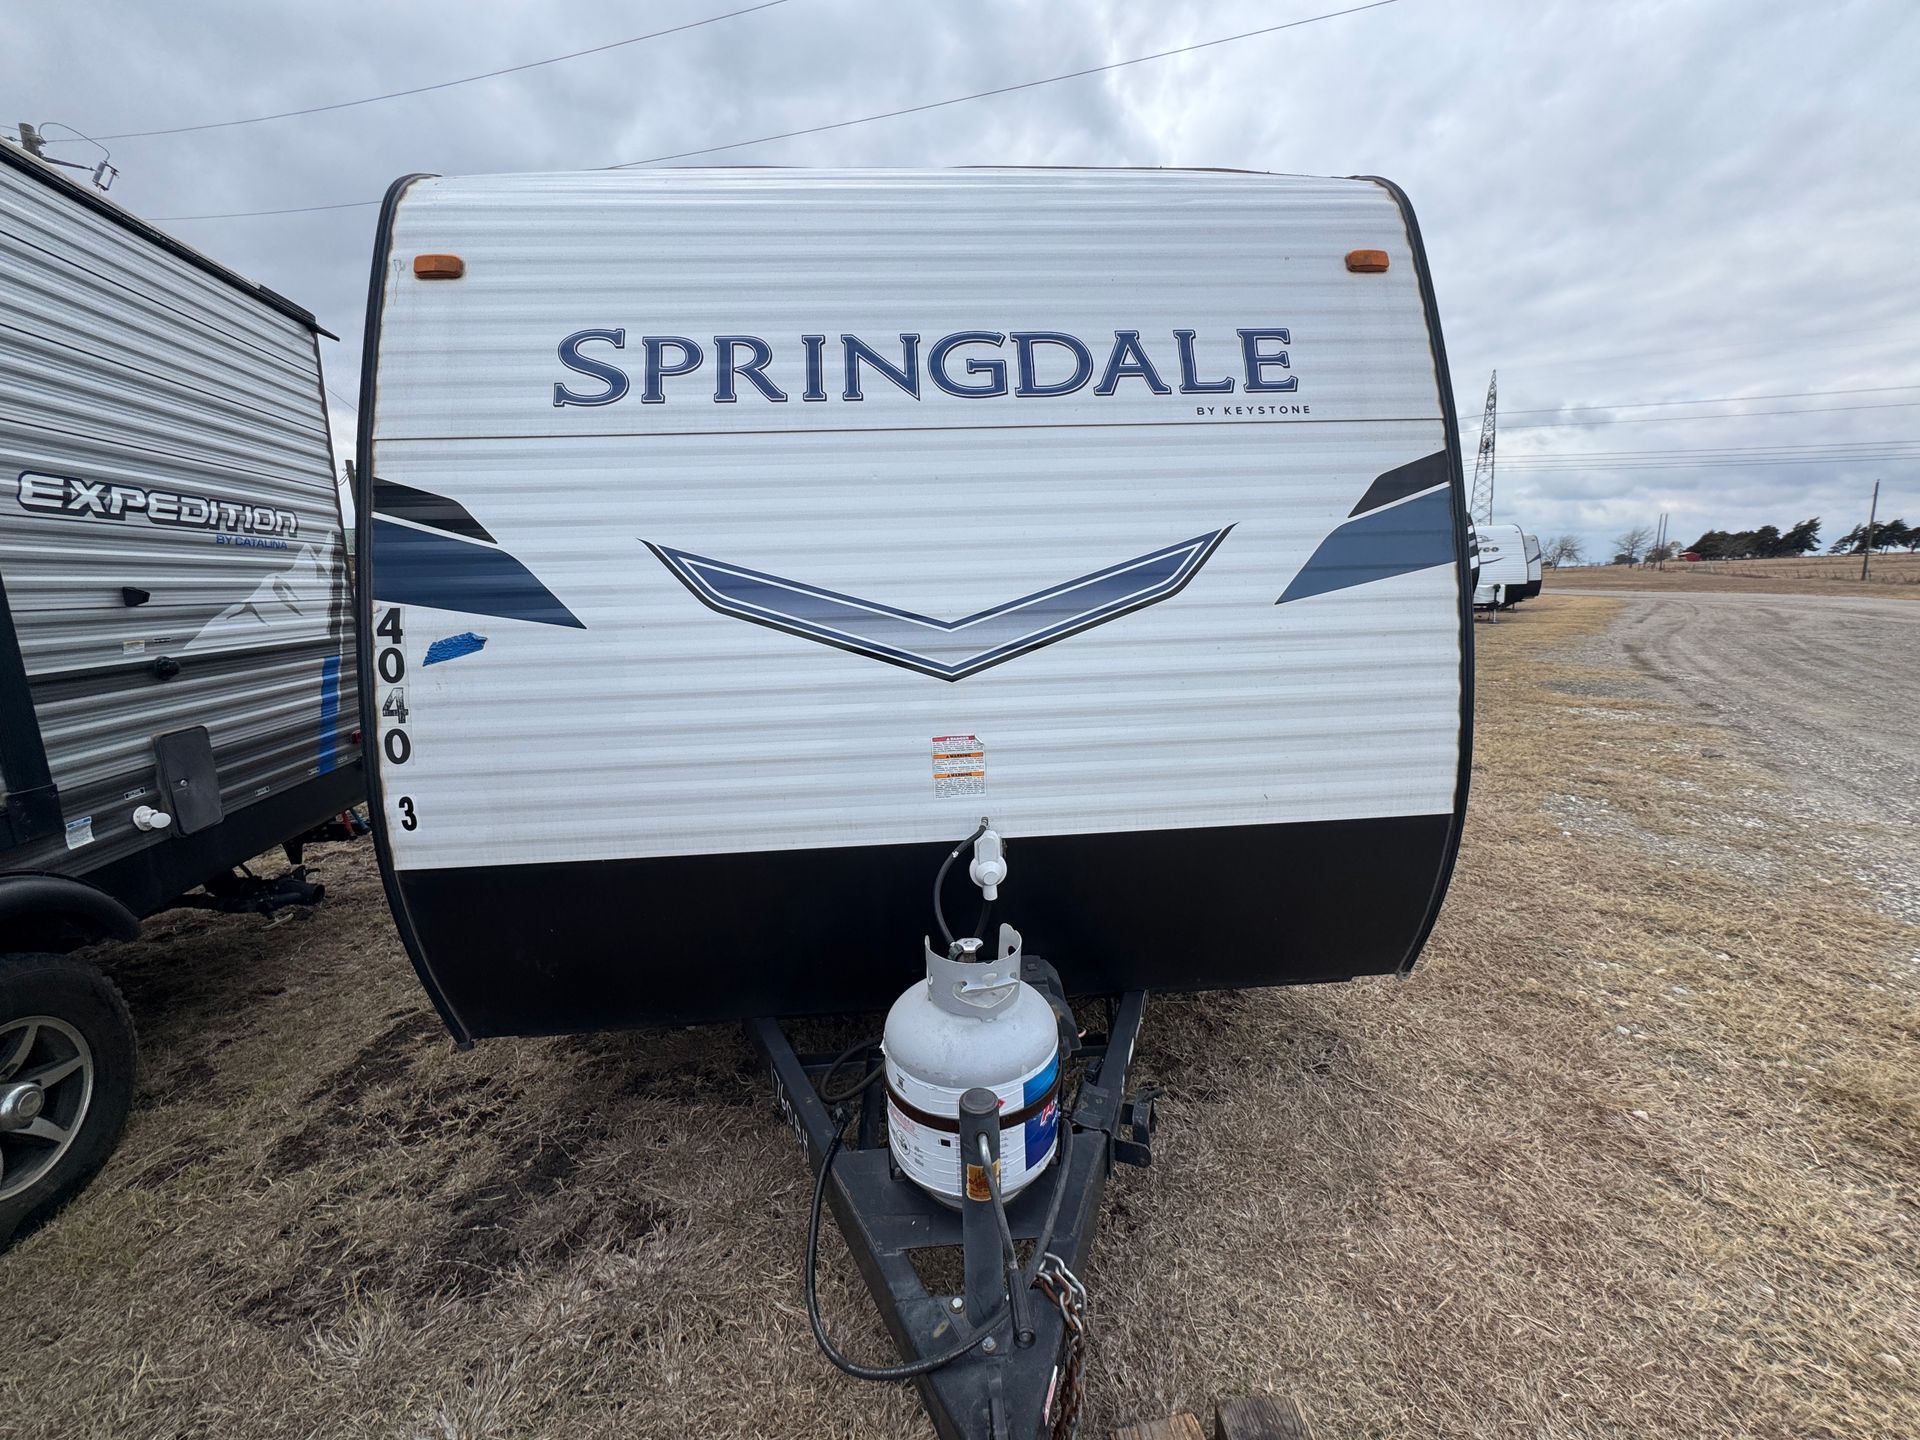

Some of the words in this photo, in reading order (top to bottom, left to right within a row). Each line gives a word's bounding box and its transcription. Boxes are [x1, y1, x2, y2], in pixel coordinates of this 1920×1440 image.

[553, 328, 1298, 407] SPRINGDALE
[1196, 406, 1215, 416] BY
[1223, 405, 1311, 416] KEYSTONE
[18, 471, 299, 538] EXPEDITION
[216, 533, 232, 545] BY
[235, 536, 288, 550] CATALINA
